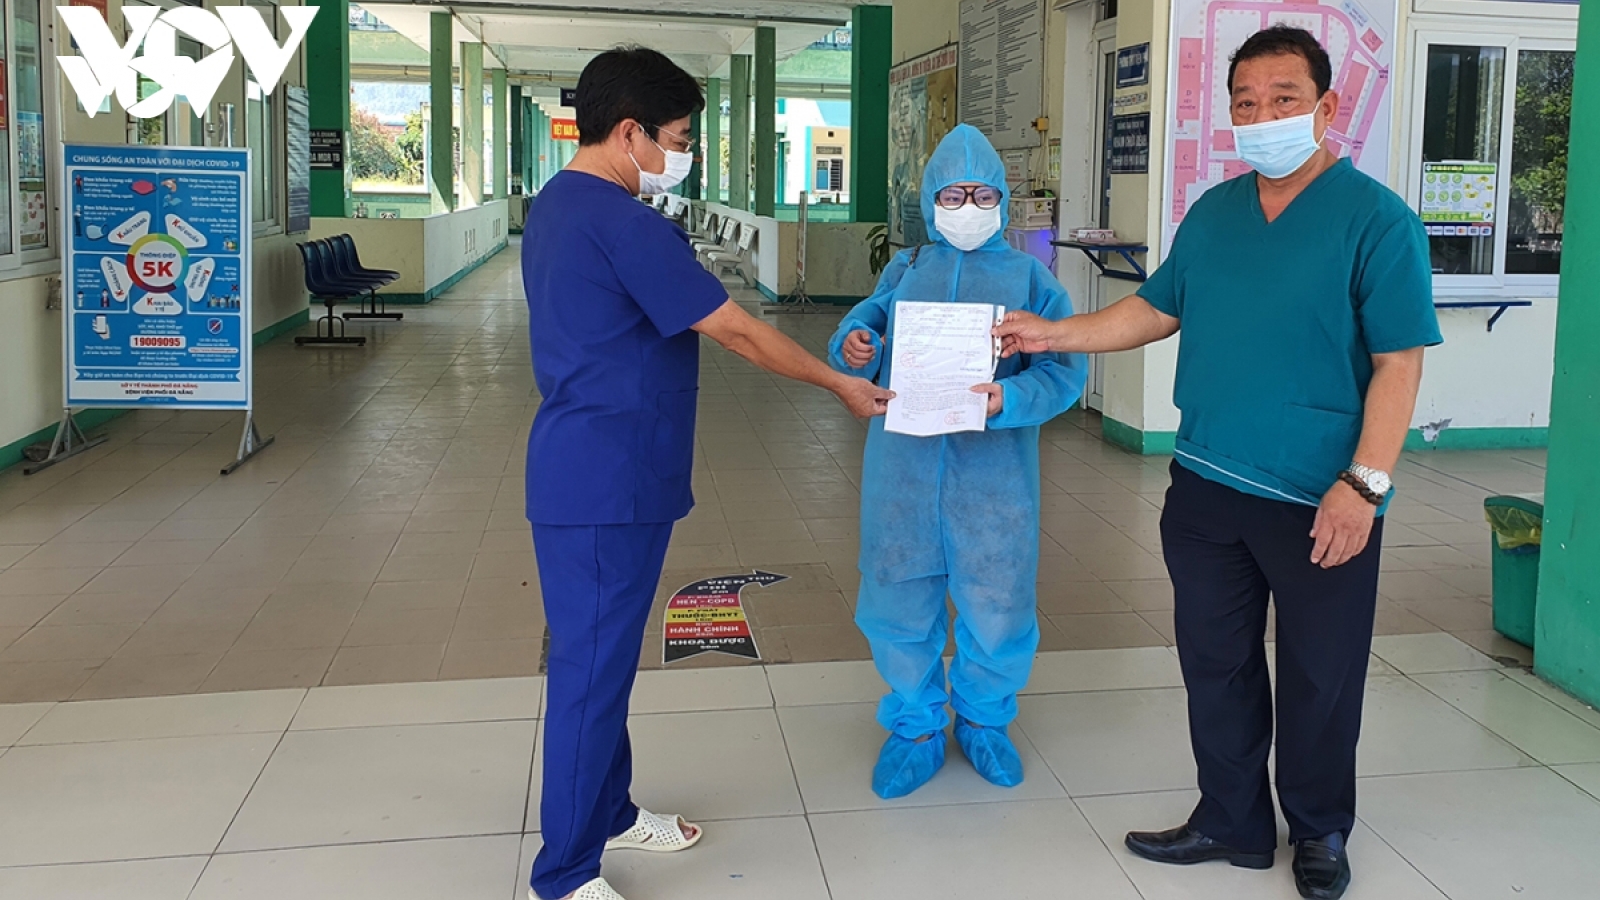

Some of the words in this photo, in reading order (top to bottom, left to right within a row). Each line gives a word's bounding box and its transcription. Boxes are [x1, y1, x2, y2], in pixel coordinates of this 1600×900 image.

[72, 154, 101, 163] CHUNG
[101, 153, 123, 164] SỐNG
[124, 156, 136, 164] AN
[137, 155, 156, 165] TOÀN
[157, 157, 172, 166] VỚI
[172, 157, 185, 168] ĐẠI
[187, 159, 205, 168] DỊCH
[206, 160, 240, 168] COVID-19
[142, 261, 174, 278] 5K
[134, 337, 181, 346] 19009095
[670, 625, 701, 634] HÀNH
[704, 624, 739, 632] CHÍNH
[669, 638, 704, 646] KHOA
[710, 636, 745, 645] DƯỢC
